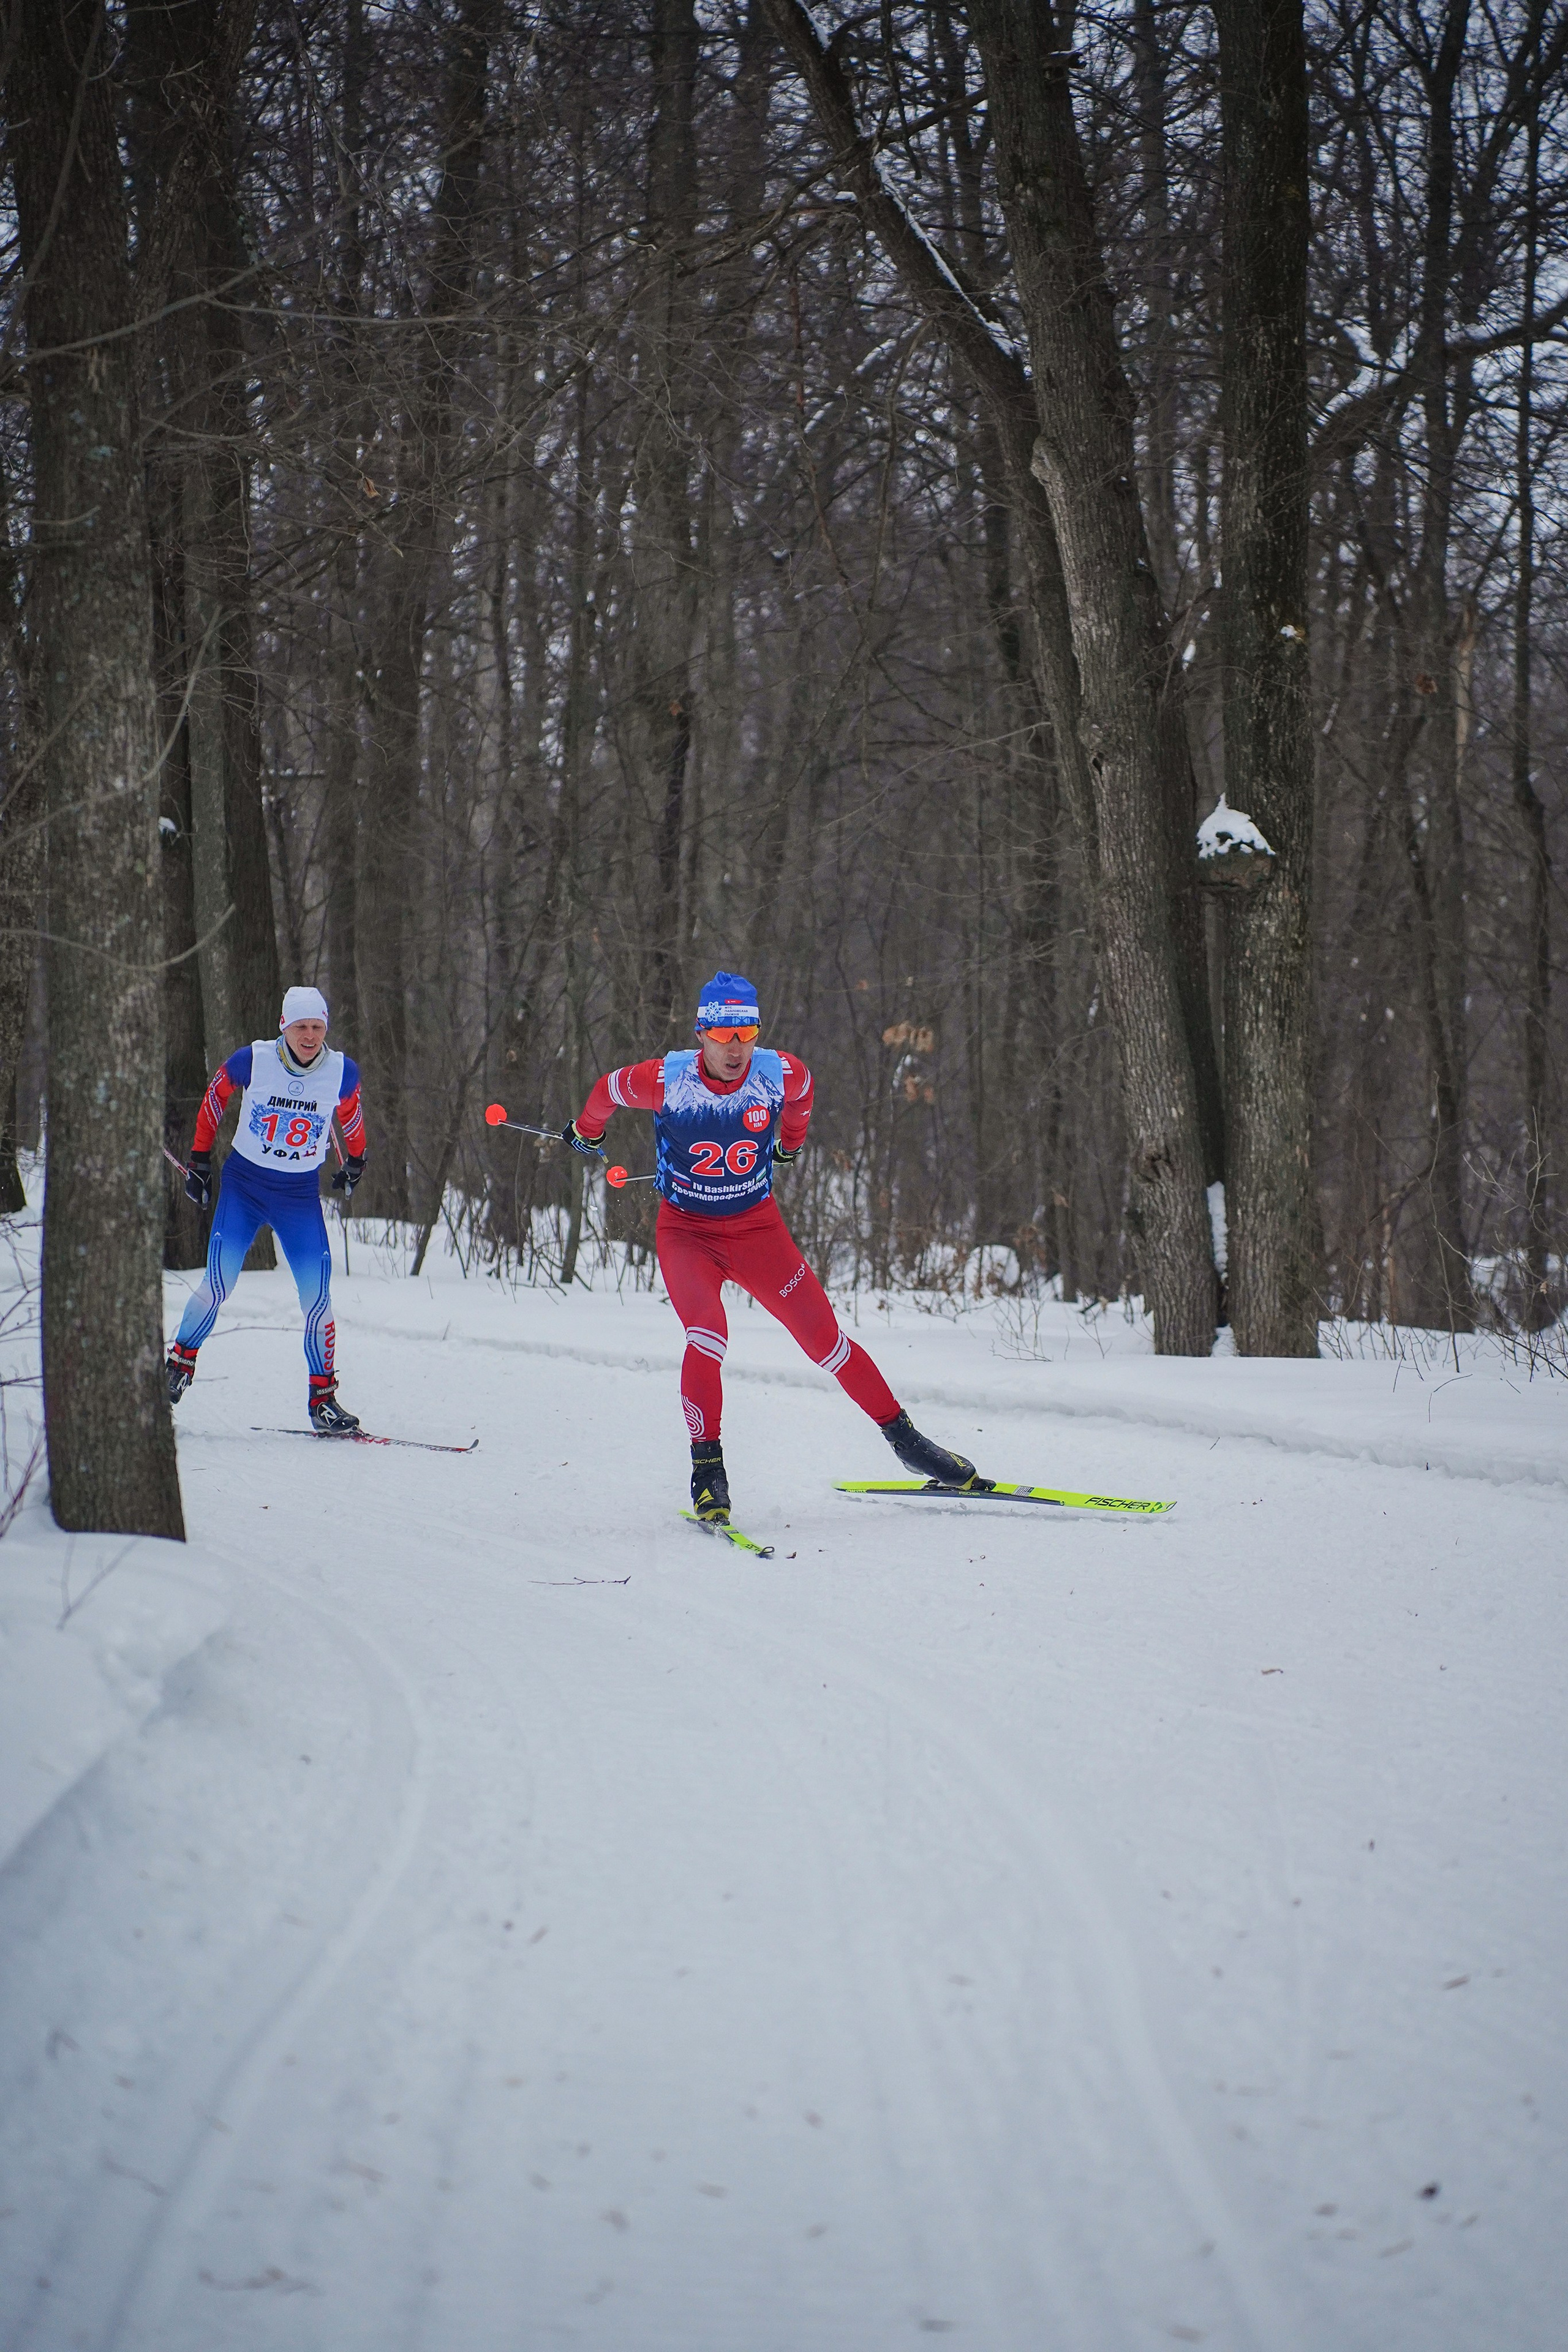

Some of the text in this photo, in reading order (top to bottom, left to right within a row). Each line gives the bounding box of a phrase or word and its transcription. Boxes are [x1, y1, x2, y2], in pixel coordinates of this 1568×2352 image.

[267, 1096, 317, 1112] ДМИТРИЙ
[747, 1109, 766, 1123] 100
[261, 1114, 312, 1147] 18
[262, 1144, 300, 1160] УФА
[688, 1140, 759, 1177] 26
[693, 1178, 755, 1194] IV BashkirSki
[779, 1267, 805, 1297] BOSCO
[1084, 1497, 1151, 1510] FISCHER
